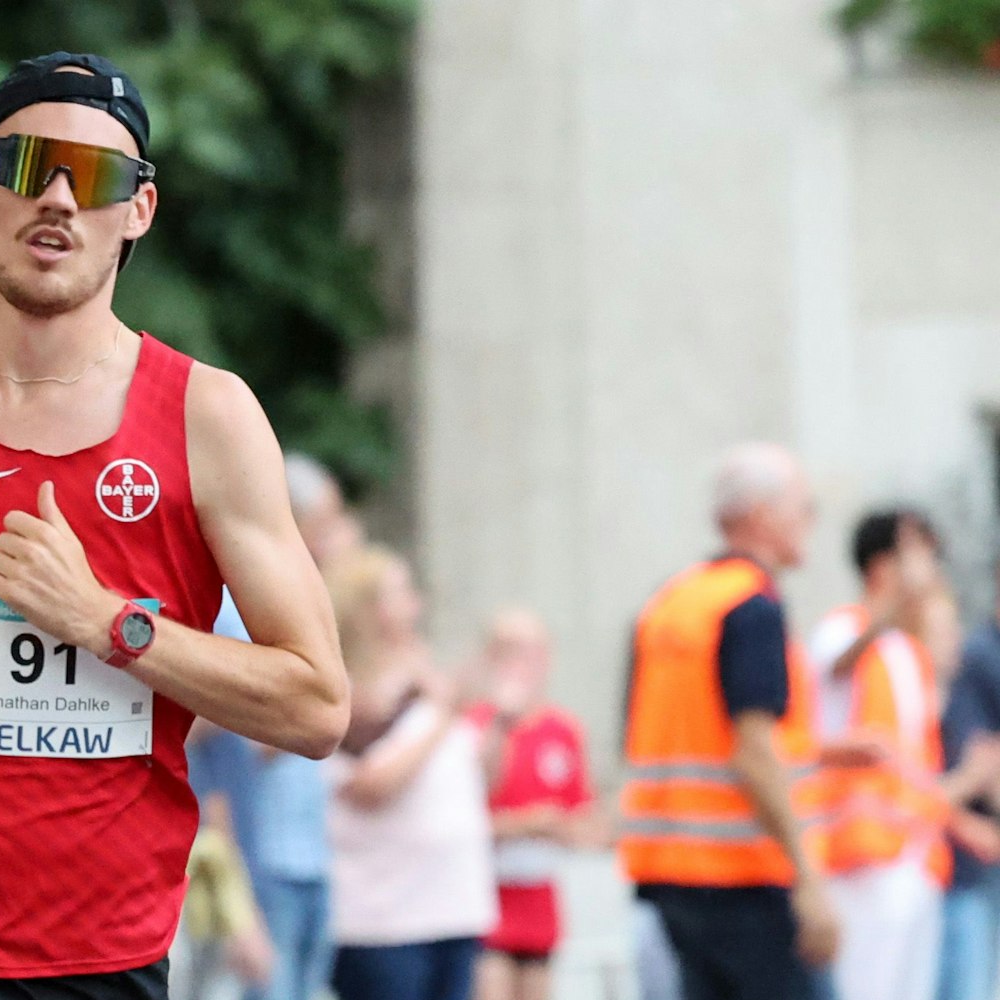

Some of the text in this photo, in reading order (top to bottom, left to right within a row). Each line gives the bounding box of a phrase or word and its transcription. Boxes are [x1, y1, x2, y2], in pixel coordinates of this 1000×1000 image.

[101, 485, 154, 496] BAYER
[122, 464, 134, 517] BAYER
[10, 633, 77, 685] 91
[55, 697, 110, 711] Dahlke
